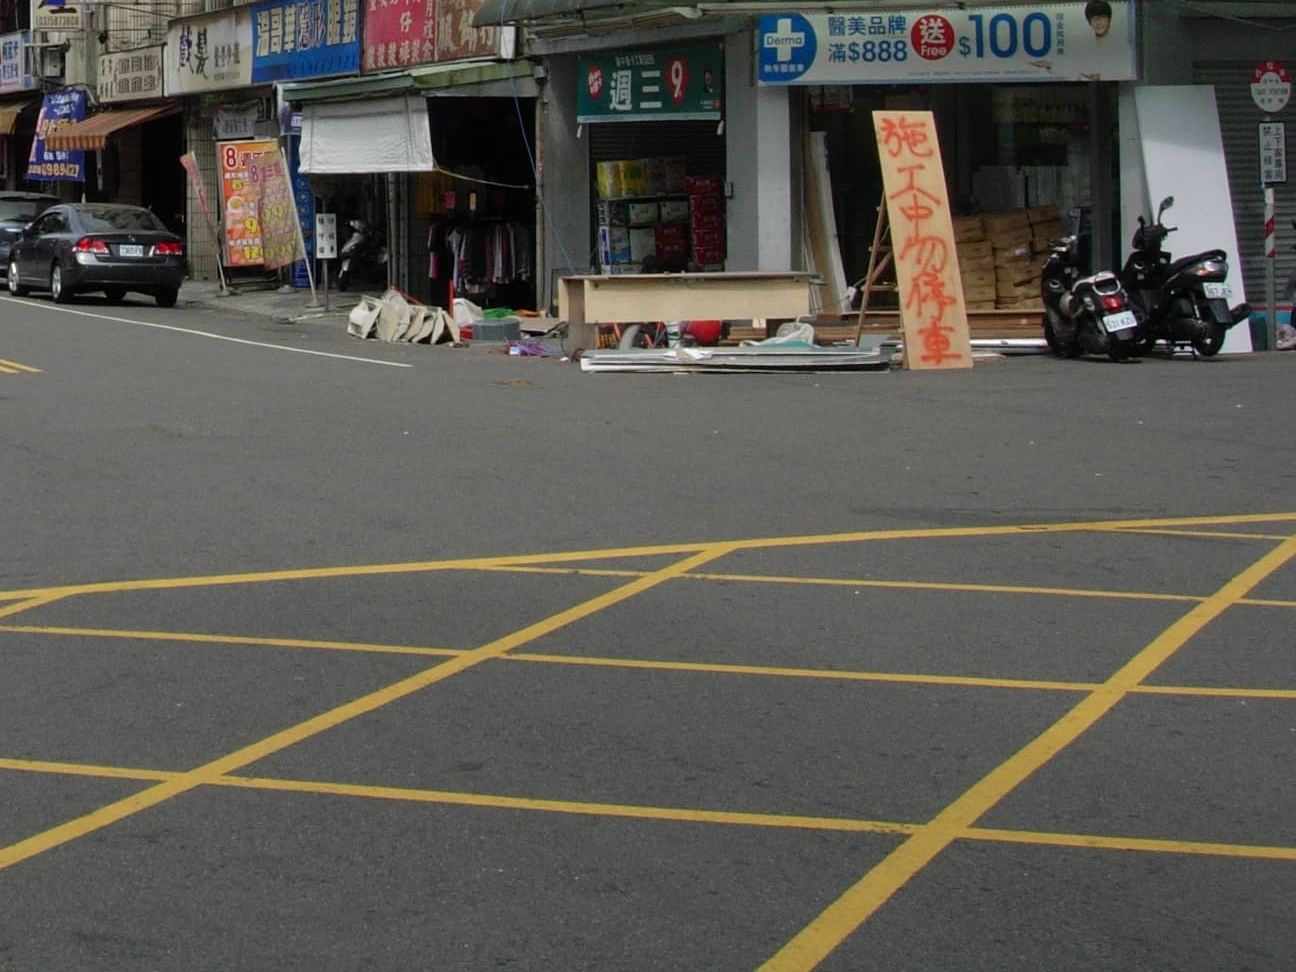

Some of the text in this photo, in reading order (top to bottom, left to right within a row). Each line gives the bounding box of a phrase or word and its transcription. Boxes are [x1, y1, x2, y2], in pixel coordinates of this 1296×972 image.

[828, 16, 907, 36] 醫美品牌
[919, 17, 946, 44] 送
[959, 12, 1051, 59] $100
[766, 36, 803, 46] Derma
[828, 39, 908, 63] 滿$888
[920, 45, 946, 57] Free
[610, 70, 662, 111] 週三
[879, 116, 962, 365] 施工中勿停車
